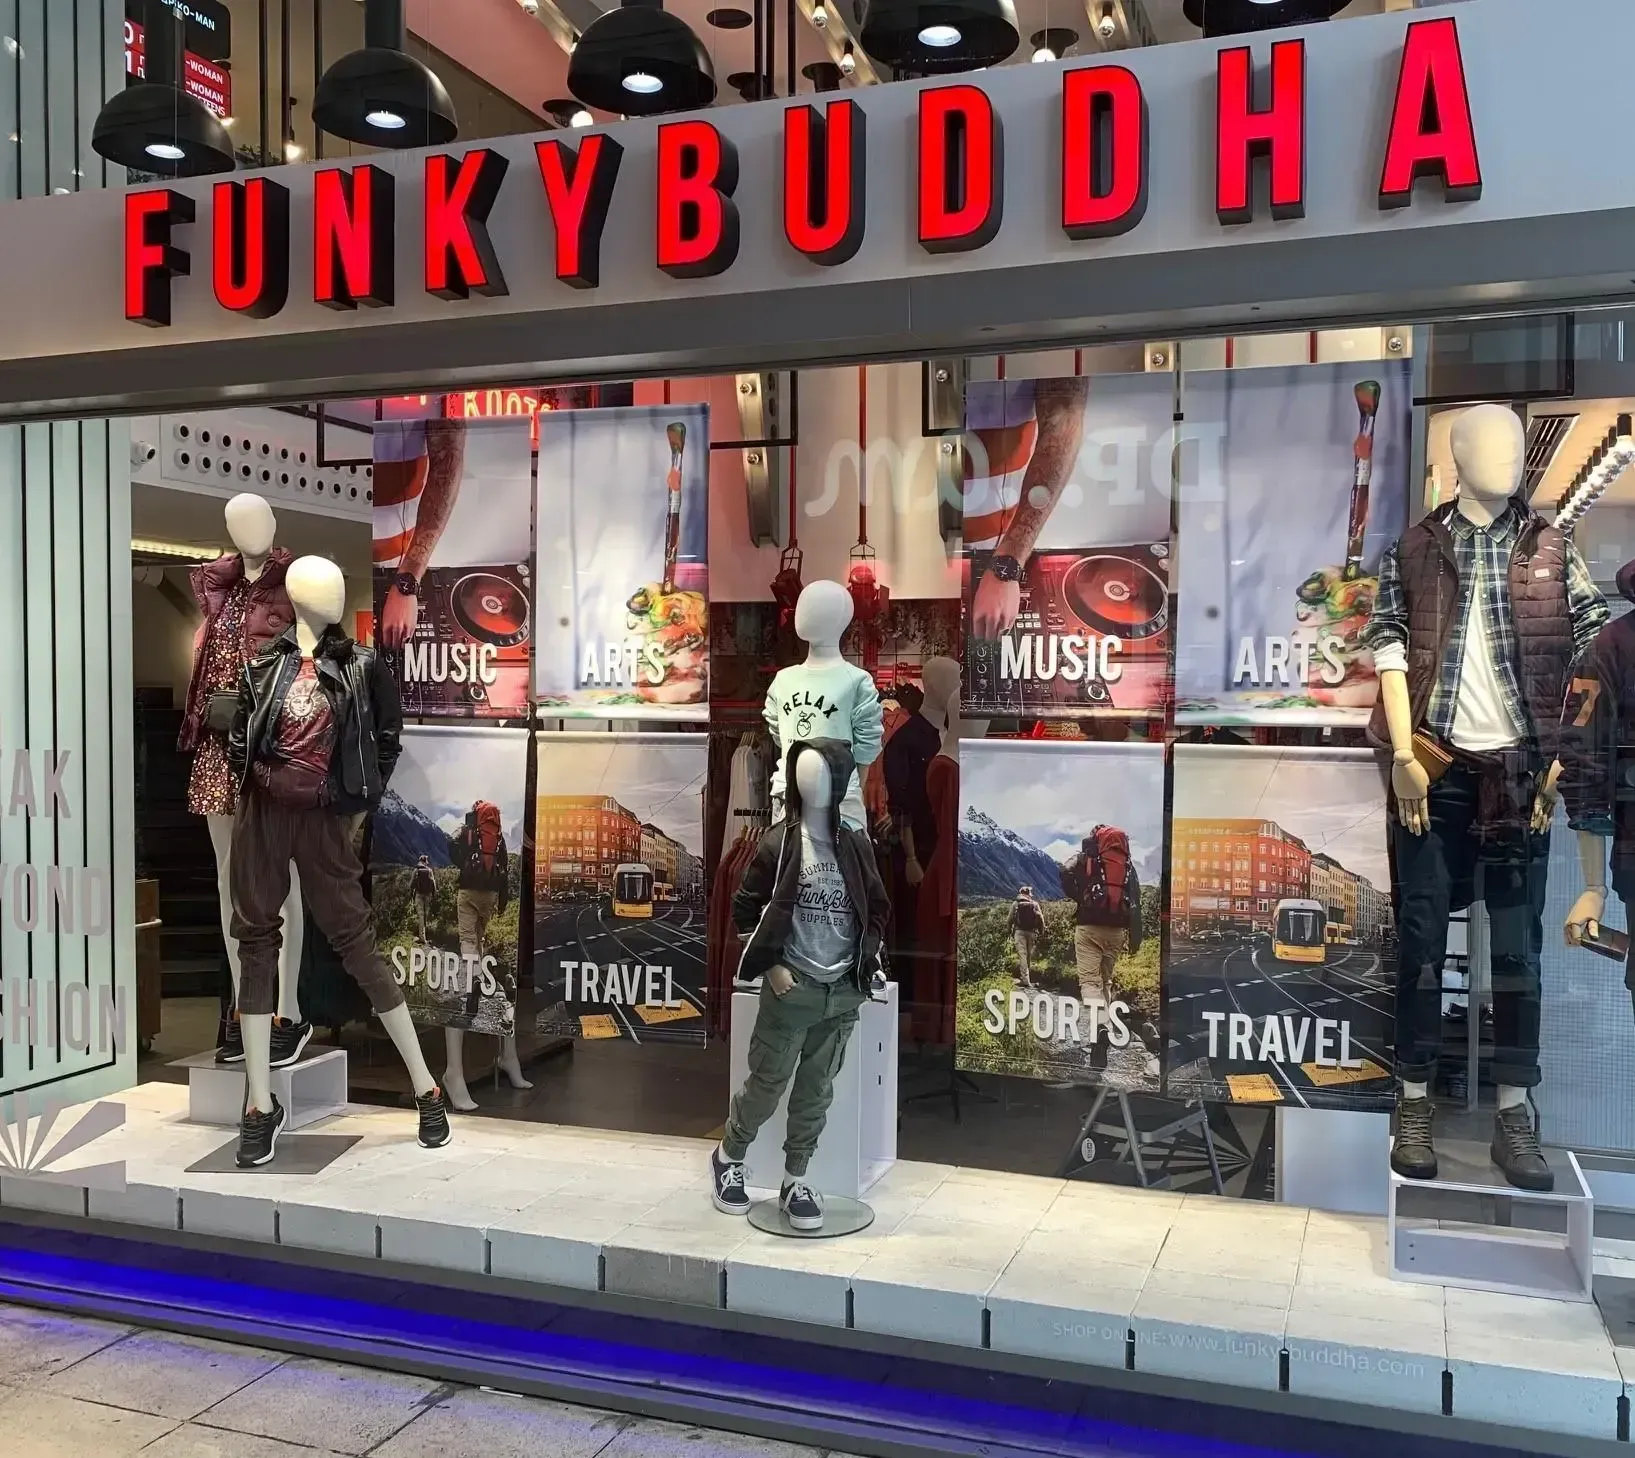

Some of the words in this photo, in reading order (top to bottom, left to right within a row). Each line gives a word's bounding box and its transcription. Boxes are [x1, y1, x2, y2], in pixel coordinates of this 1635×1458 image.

[124, 17, 1482, 325] FUNKYBUDDHA
[403, 641, 498, 685] MUSIC
[581, 641, 666, 686] ARTS
[1000, 634, 1123, 682] MUSIC
[1233, 636, 1346, 685] ARTS
[783, 691, 839, 719] RELAX
[391, 946, 498, 996] SPORTS
[560, 960, 682, 1008] TRAVEL
[983, 988, 1131, 1048] SPORTS
[1201, 1011, 1363, 1069] TRAVEL
[1052, 1322, 1096, 1338] SHOP
